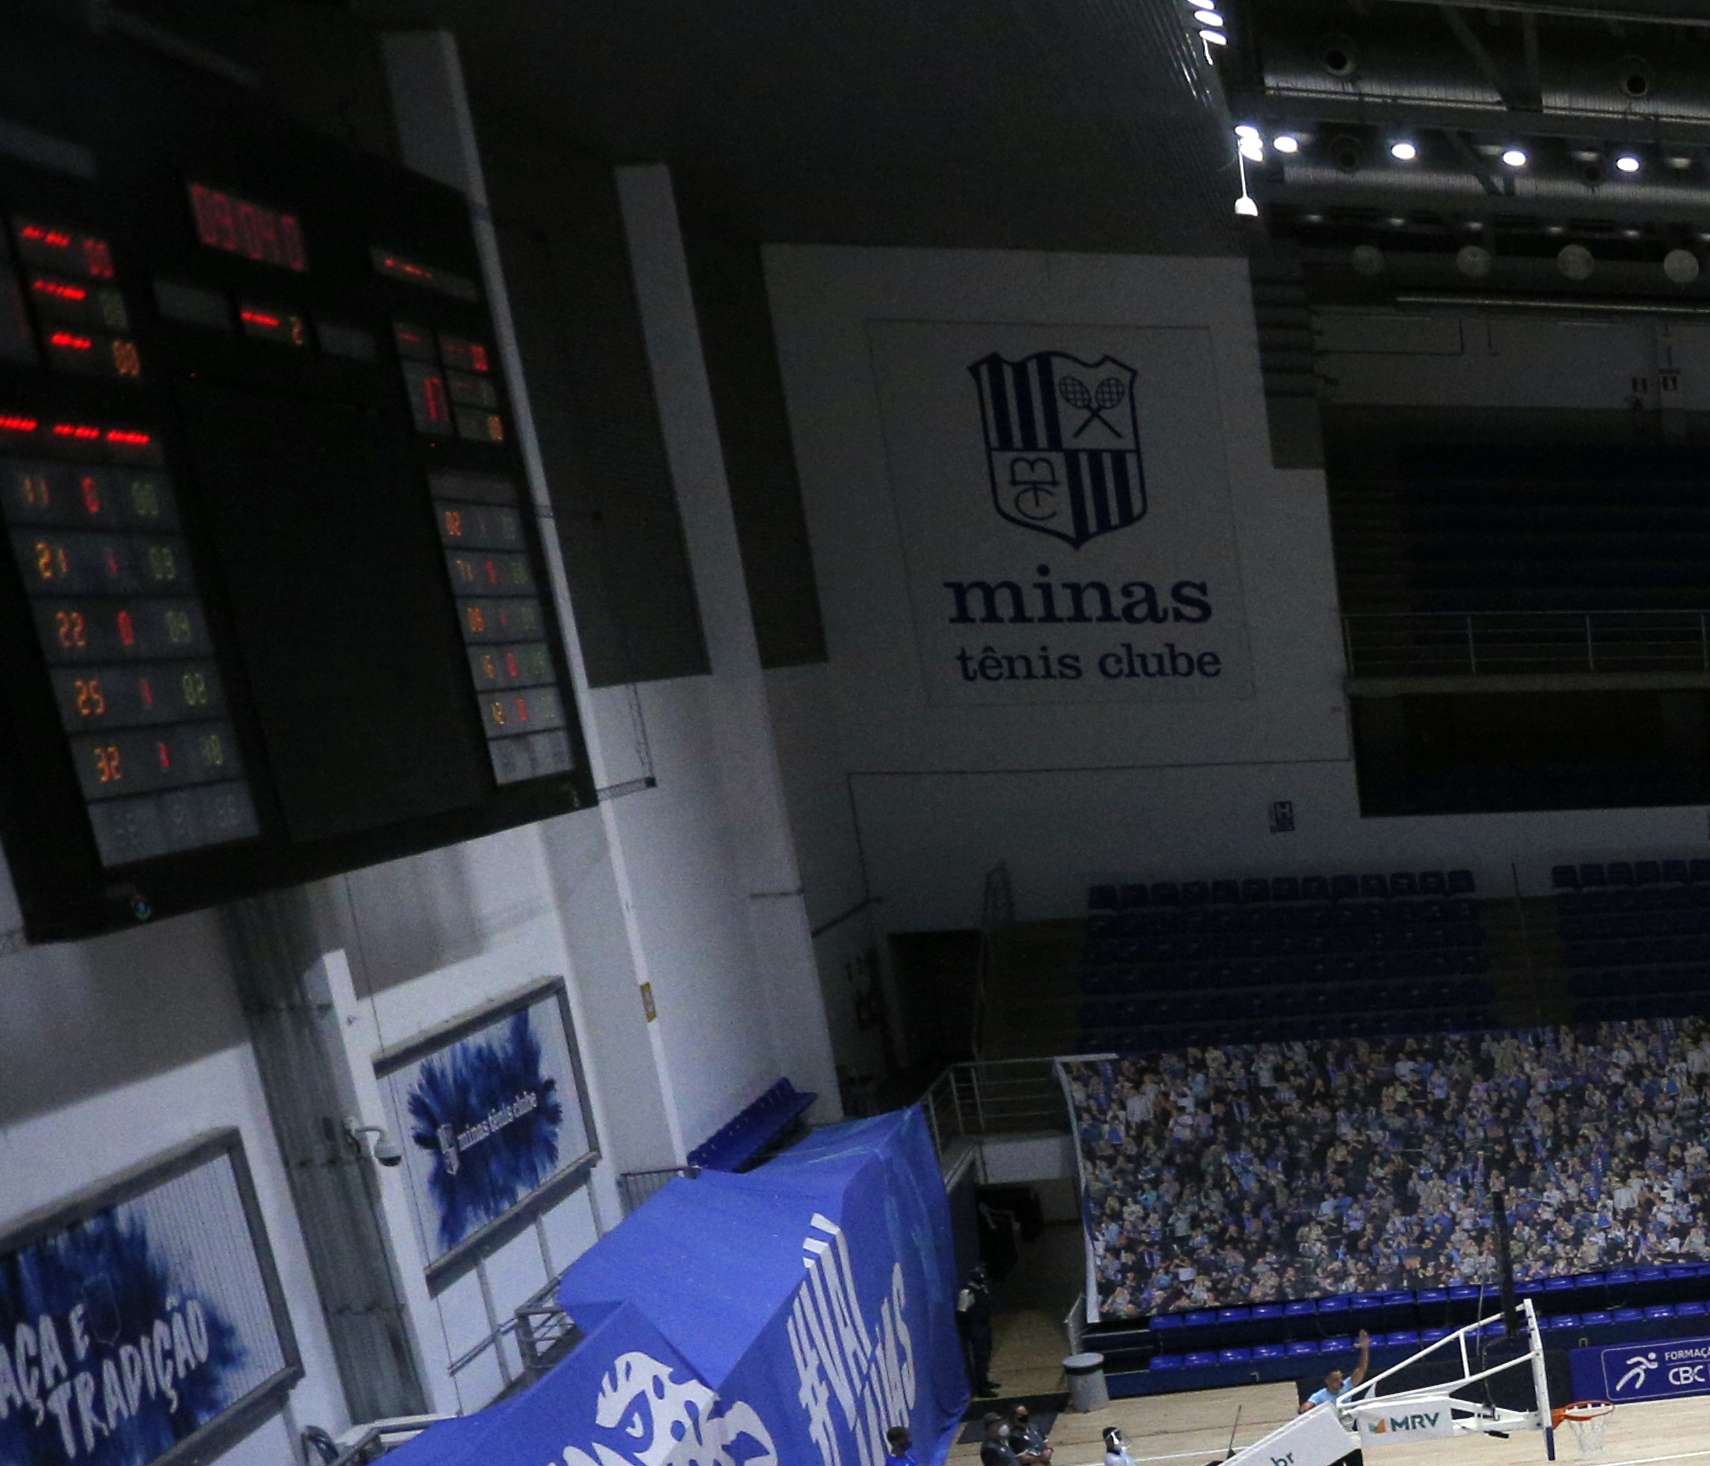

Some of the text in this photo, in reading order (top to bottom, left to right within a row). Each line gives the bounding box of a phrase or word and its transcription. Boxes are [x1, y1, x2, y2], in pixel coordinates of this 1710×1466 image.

[943, 564, 1213, 625] minas
[957, 642, 1222, 682] tênis clube
[75, 679, 107, 716] 25
[69, 1303, 90, 1361] E
[47, 1295, 210, 1460] TRADIÇÃO
[1668, 1366, 1706, 1386] CBC
[1390, 1412, 1440, 1433] MRV
